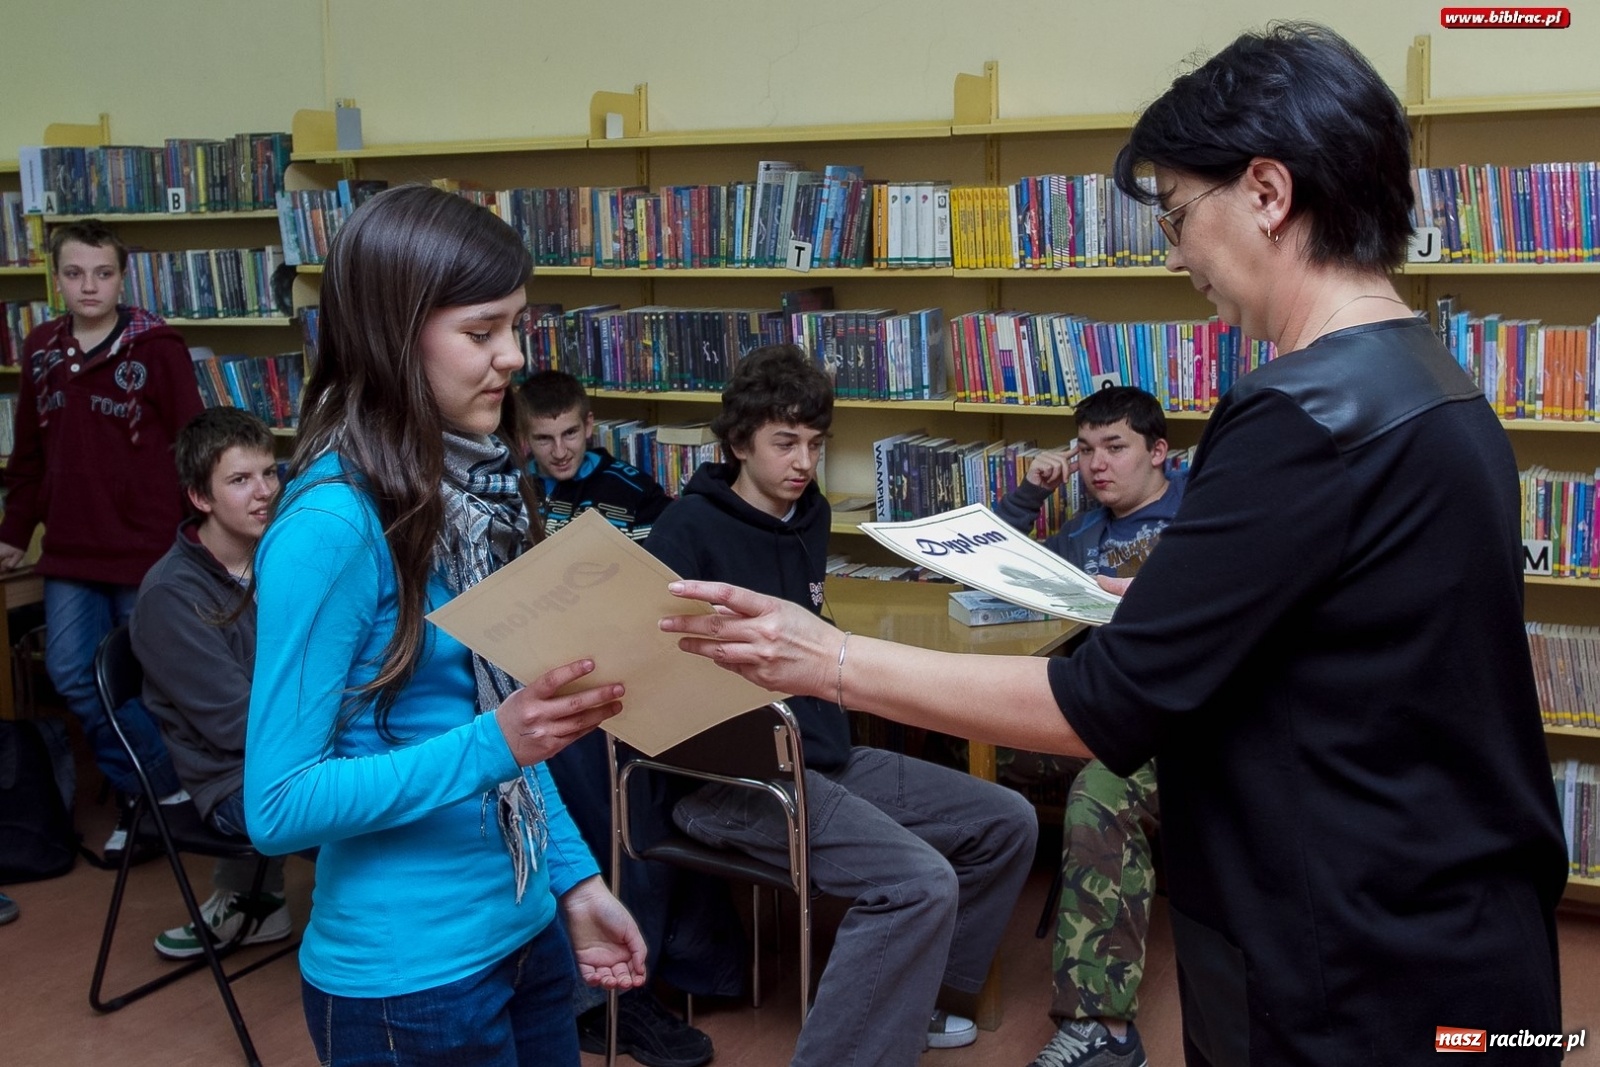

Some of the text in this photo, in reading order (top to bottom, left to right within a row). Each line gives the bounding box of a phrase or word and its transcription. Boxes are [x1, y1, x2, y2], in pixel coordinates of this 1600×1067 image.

[46, 194, 55, 213] A
[172, 193, 181, 211] B
[794, 245, 806, 267] T
[1417, 233, 1433, 258] J
[875, 444, 886, 518] WAMPIRY
[916, 530, 1008, 556] Dyplom
[1522, 545, 1549, 571] M
